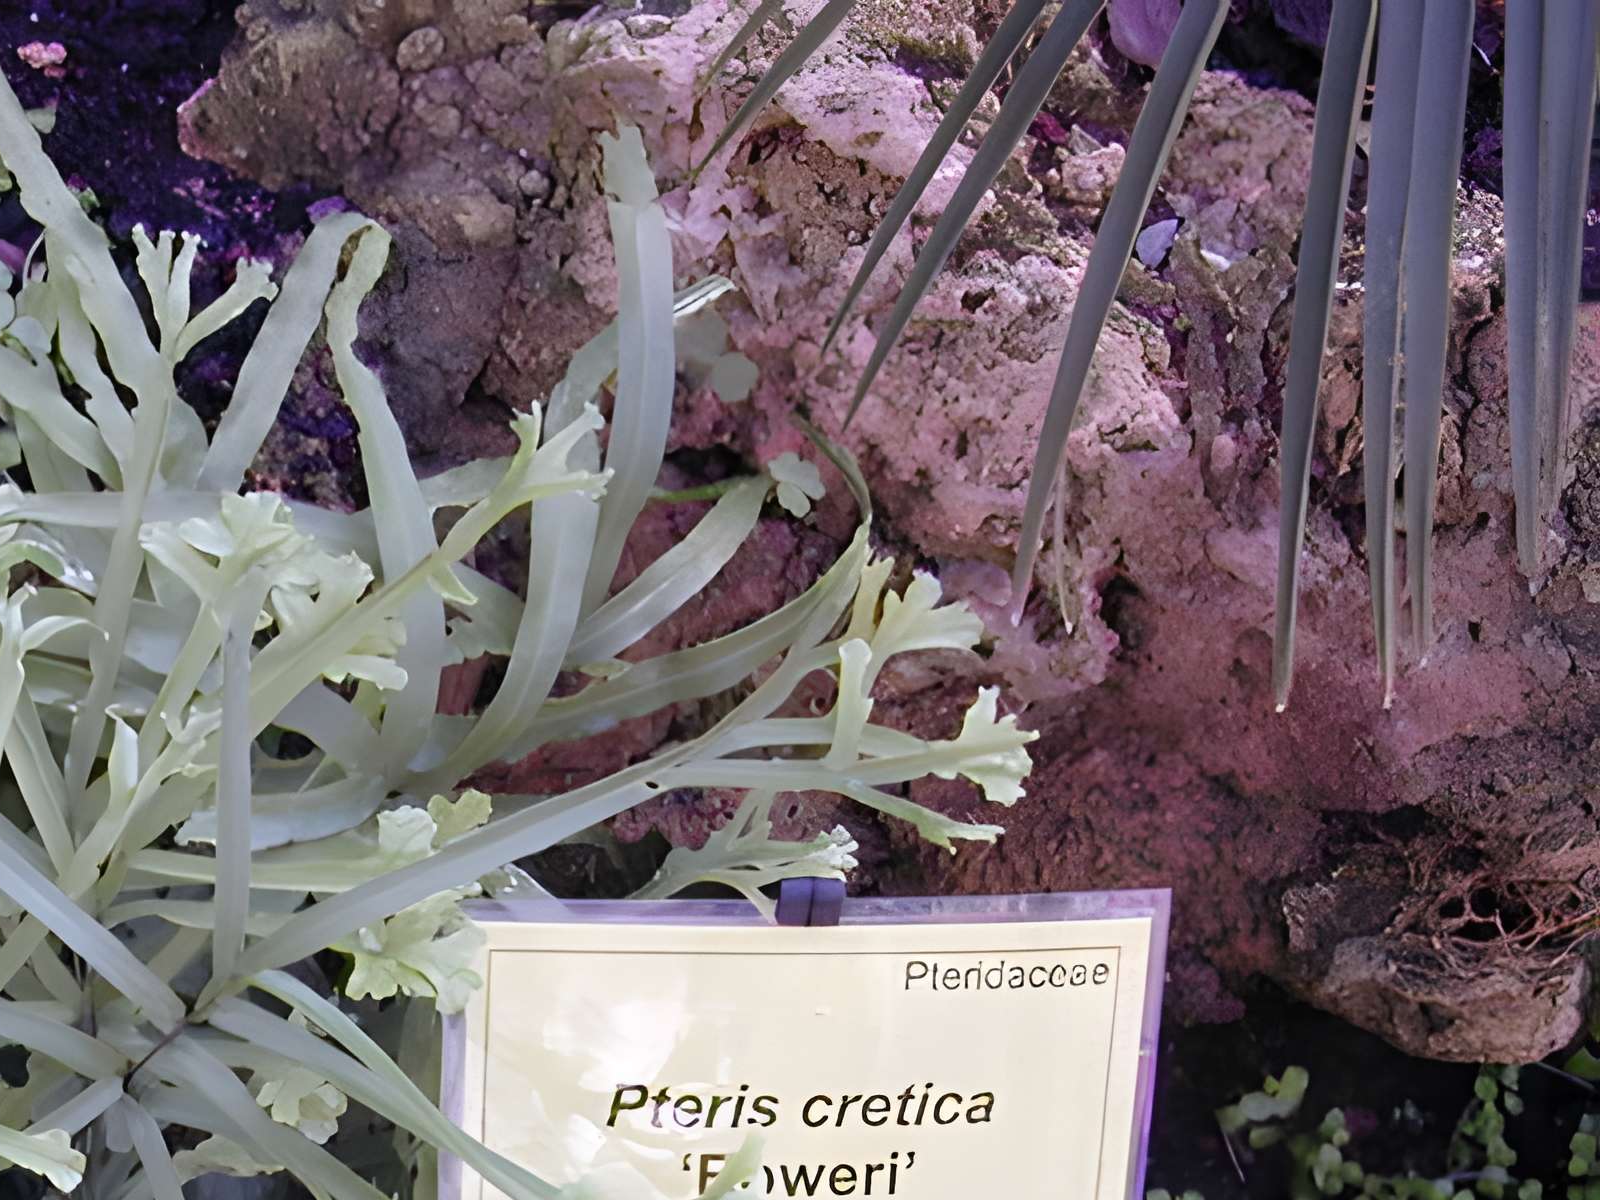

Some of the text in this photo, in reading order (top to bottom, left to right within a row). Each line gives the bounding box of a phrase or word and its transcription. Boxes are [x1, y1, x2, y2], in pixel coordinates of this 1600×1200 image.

[905, 960, 1110, 991] Pteridaceae
[606, 1081, 997, 1129] Pteris cretica
